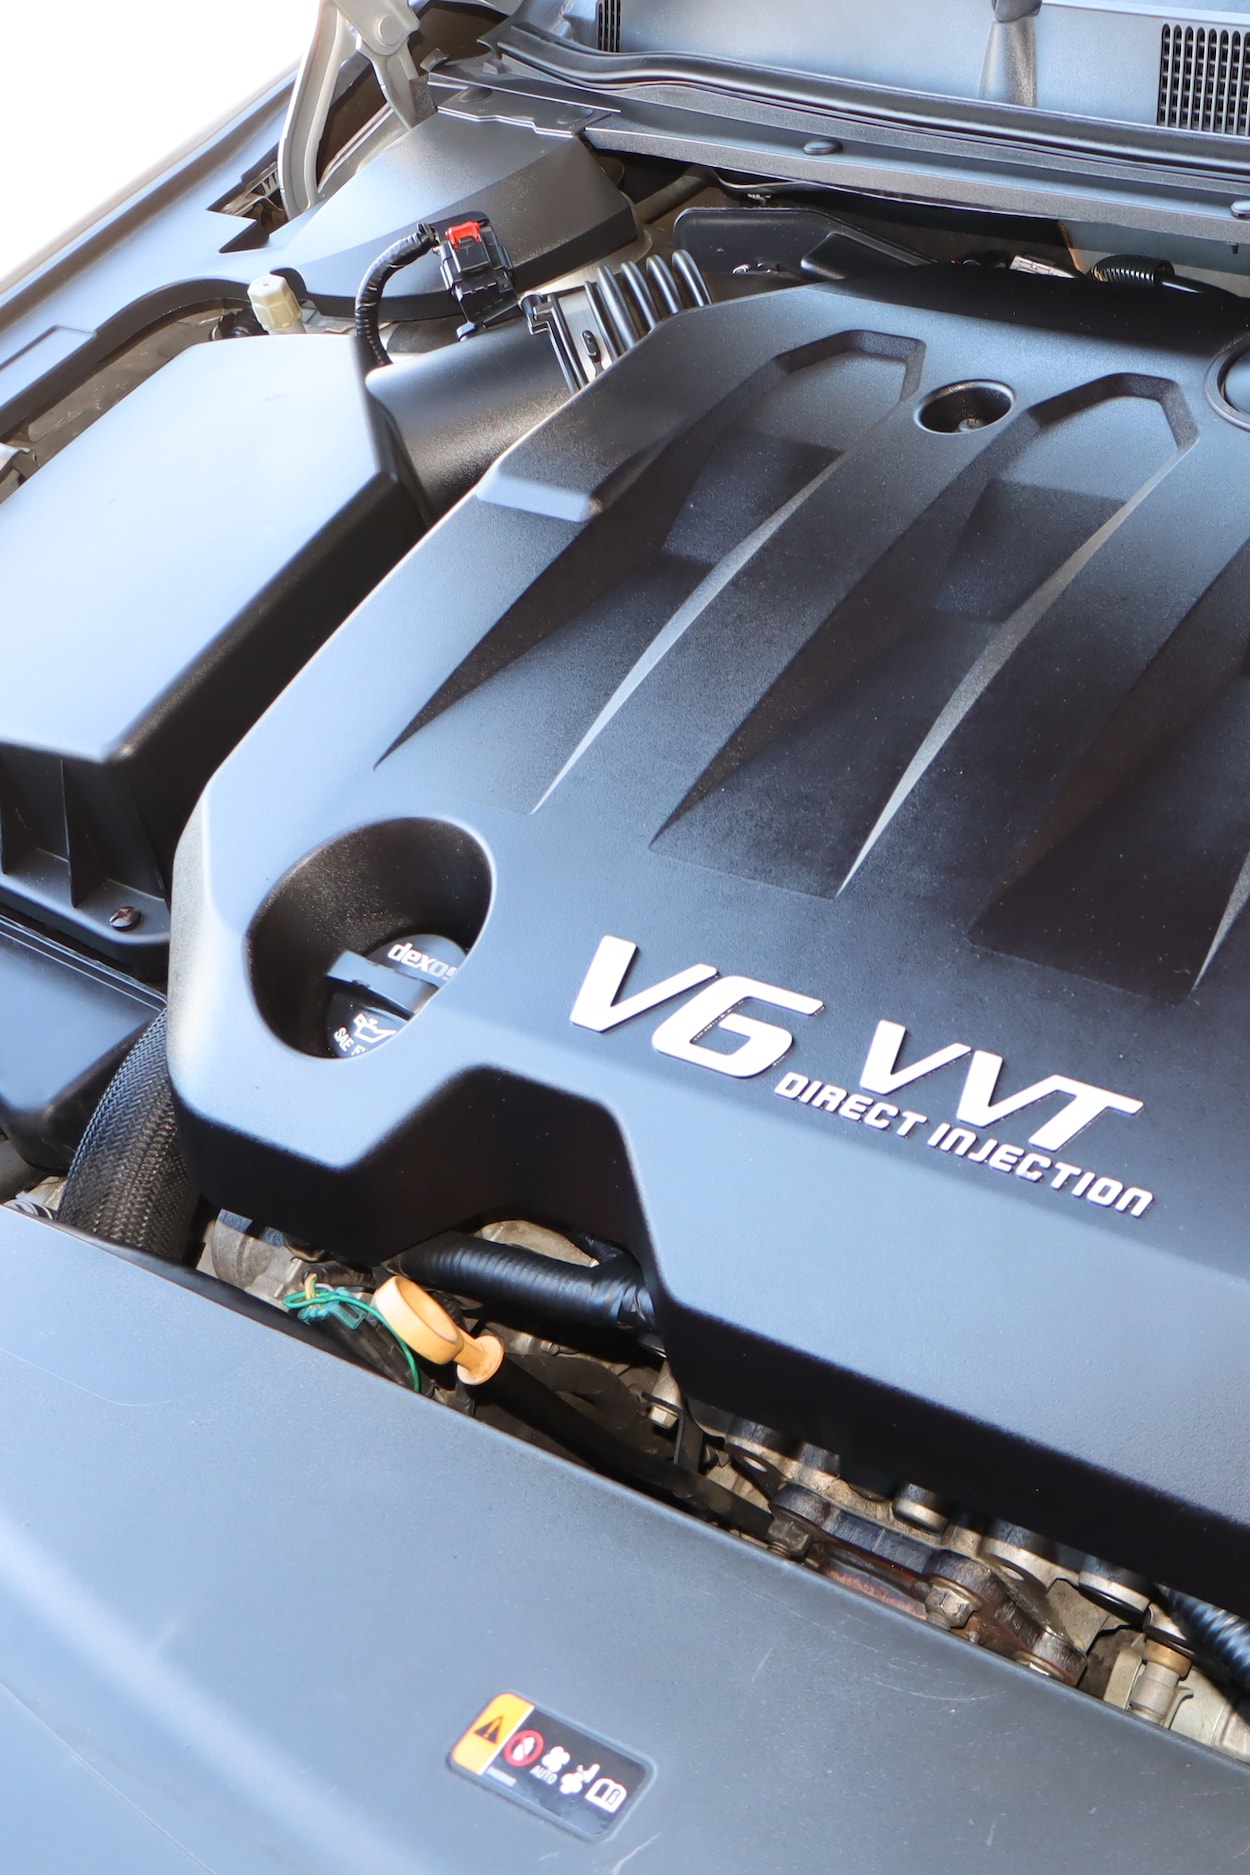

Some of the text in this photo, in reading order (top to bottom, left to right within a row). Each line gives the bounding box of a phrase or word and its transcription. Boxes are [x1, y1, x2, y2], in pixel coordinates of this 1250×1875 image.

[334, 1026, 355, 1052] SAE
[569, 935, 1144, 1152] V6 VVT
[773, 1071, 1154, 1218] DIRECT INJECTION
[530, 1765, 558, 1785] AUTO
